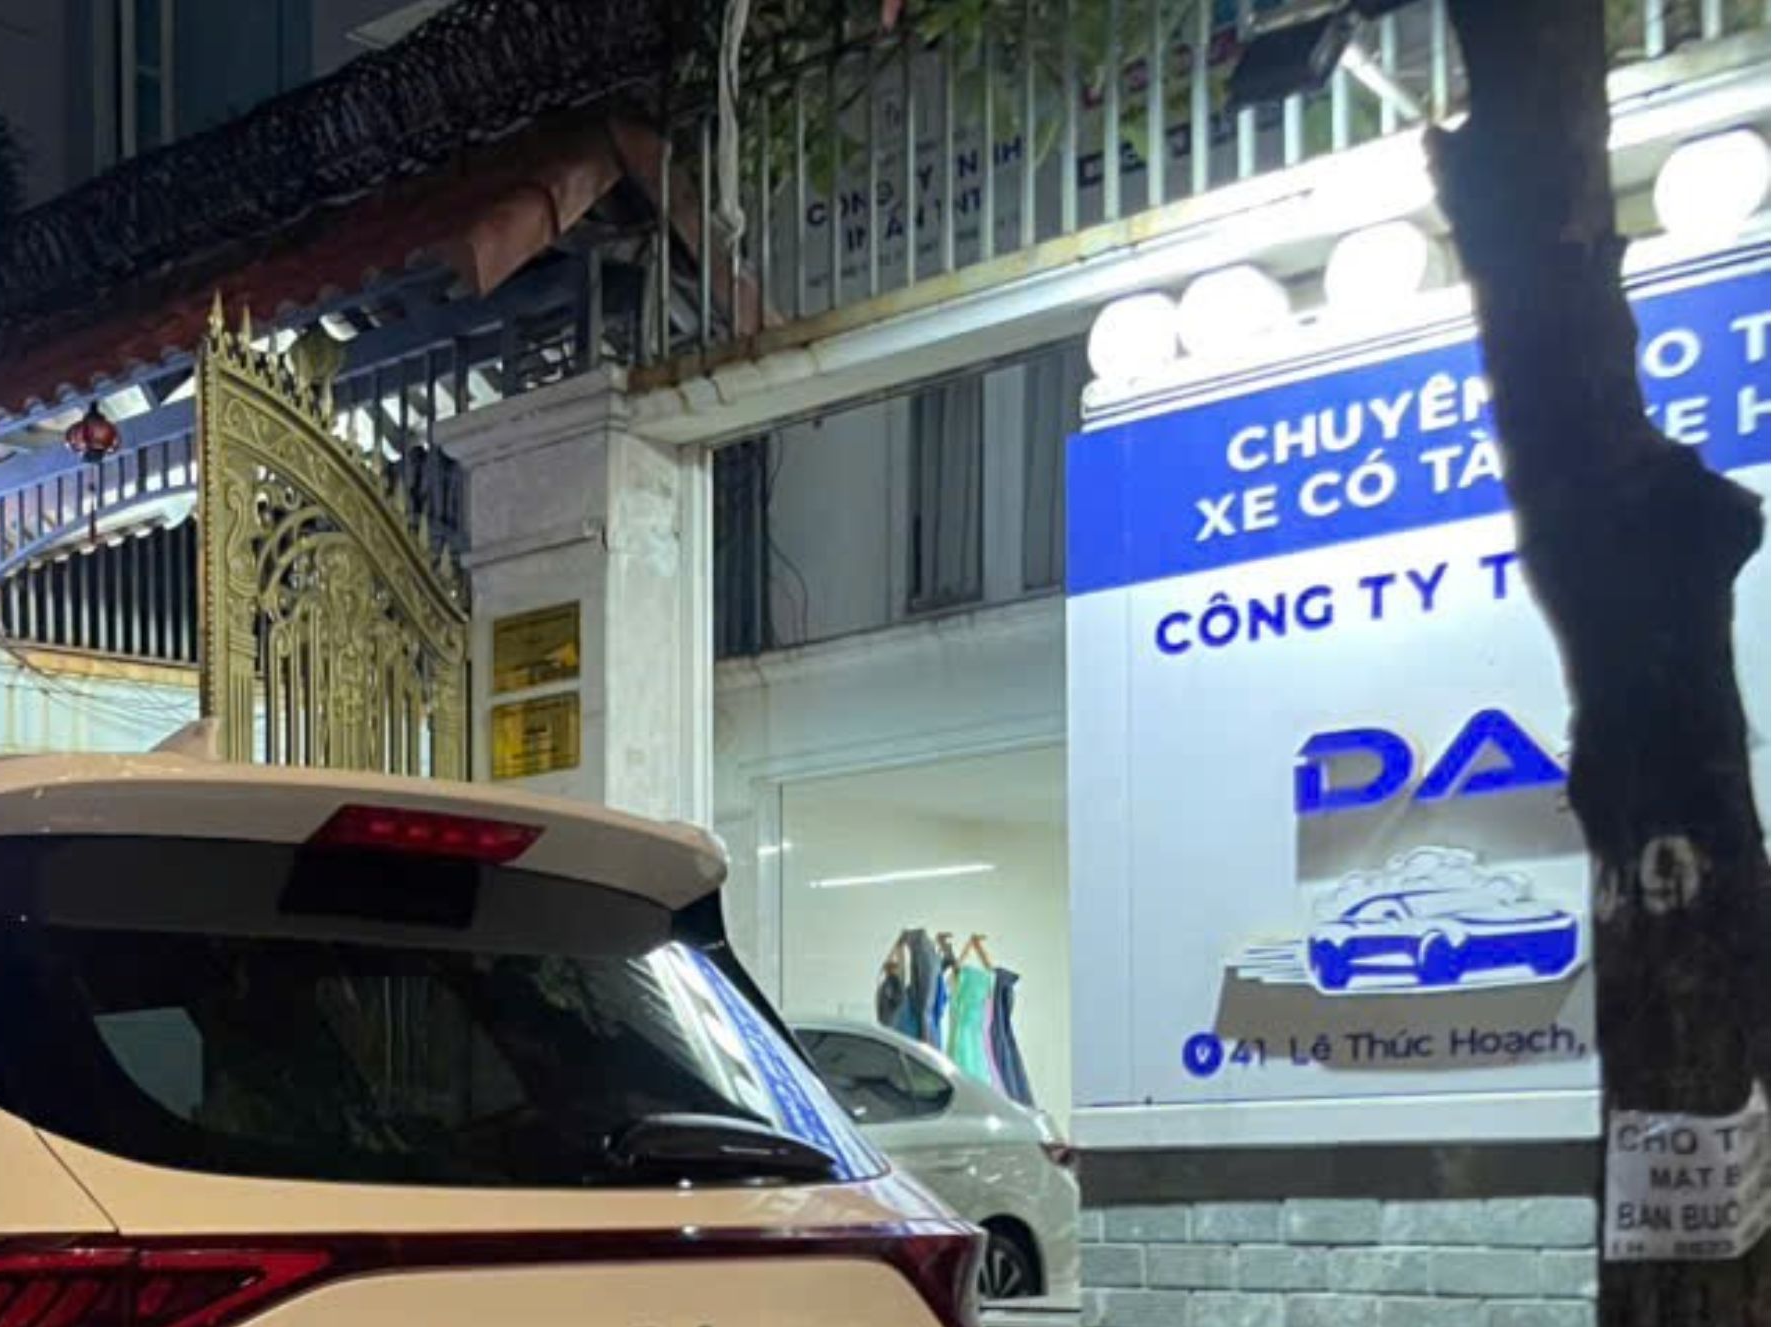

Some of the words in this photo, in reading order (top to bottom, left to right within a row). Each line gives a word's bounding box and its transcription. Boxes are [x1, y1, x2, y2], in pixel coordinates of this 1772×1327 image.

[1729, 311, 1772, 364] T
[1194, 484, 1280, 542] XE
[1297, 448, 1397, 518] CÓ
[1418, 429, 1504, 494] TÀ
[1644, 395, 1711, 446] E
[1736, 385, 1772, 436] H
[1154, 590, 1334, 655] CÔNG
[1358, 562, 1449, 621] TY
[1479, 551, 1520, 600] T
[1293, 707, 1569, 816] DA
[1228, 1037, 1267, 1067] 41
[1289, 1035, 1332, 1067] Lê
[1344, 1028, 1434, 1061] Thúc
